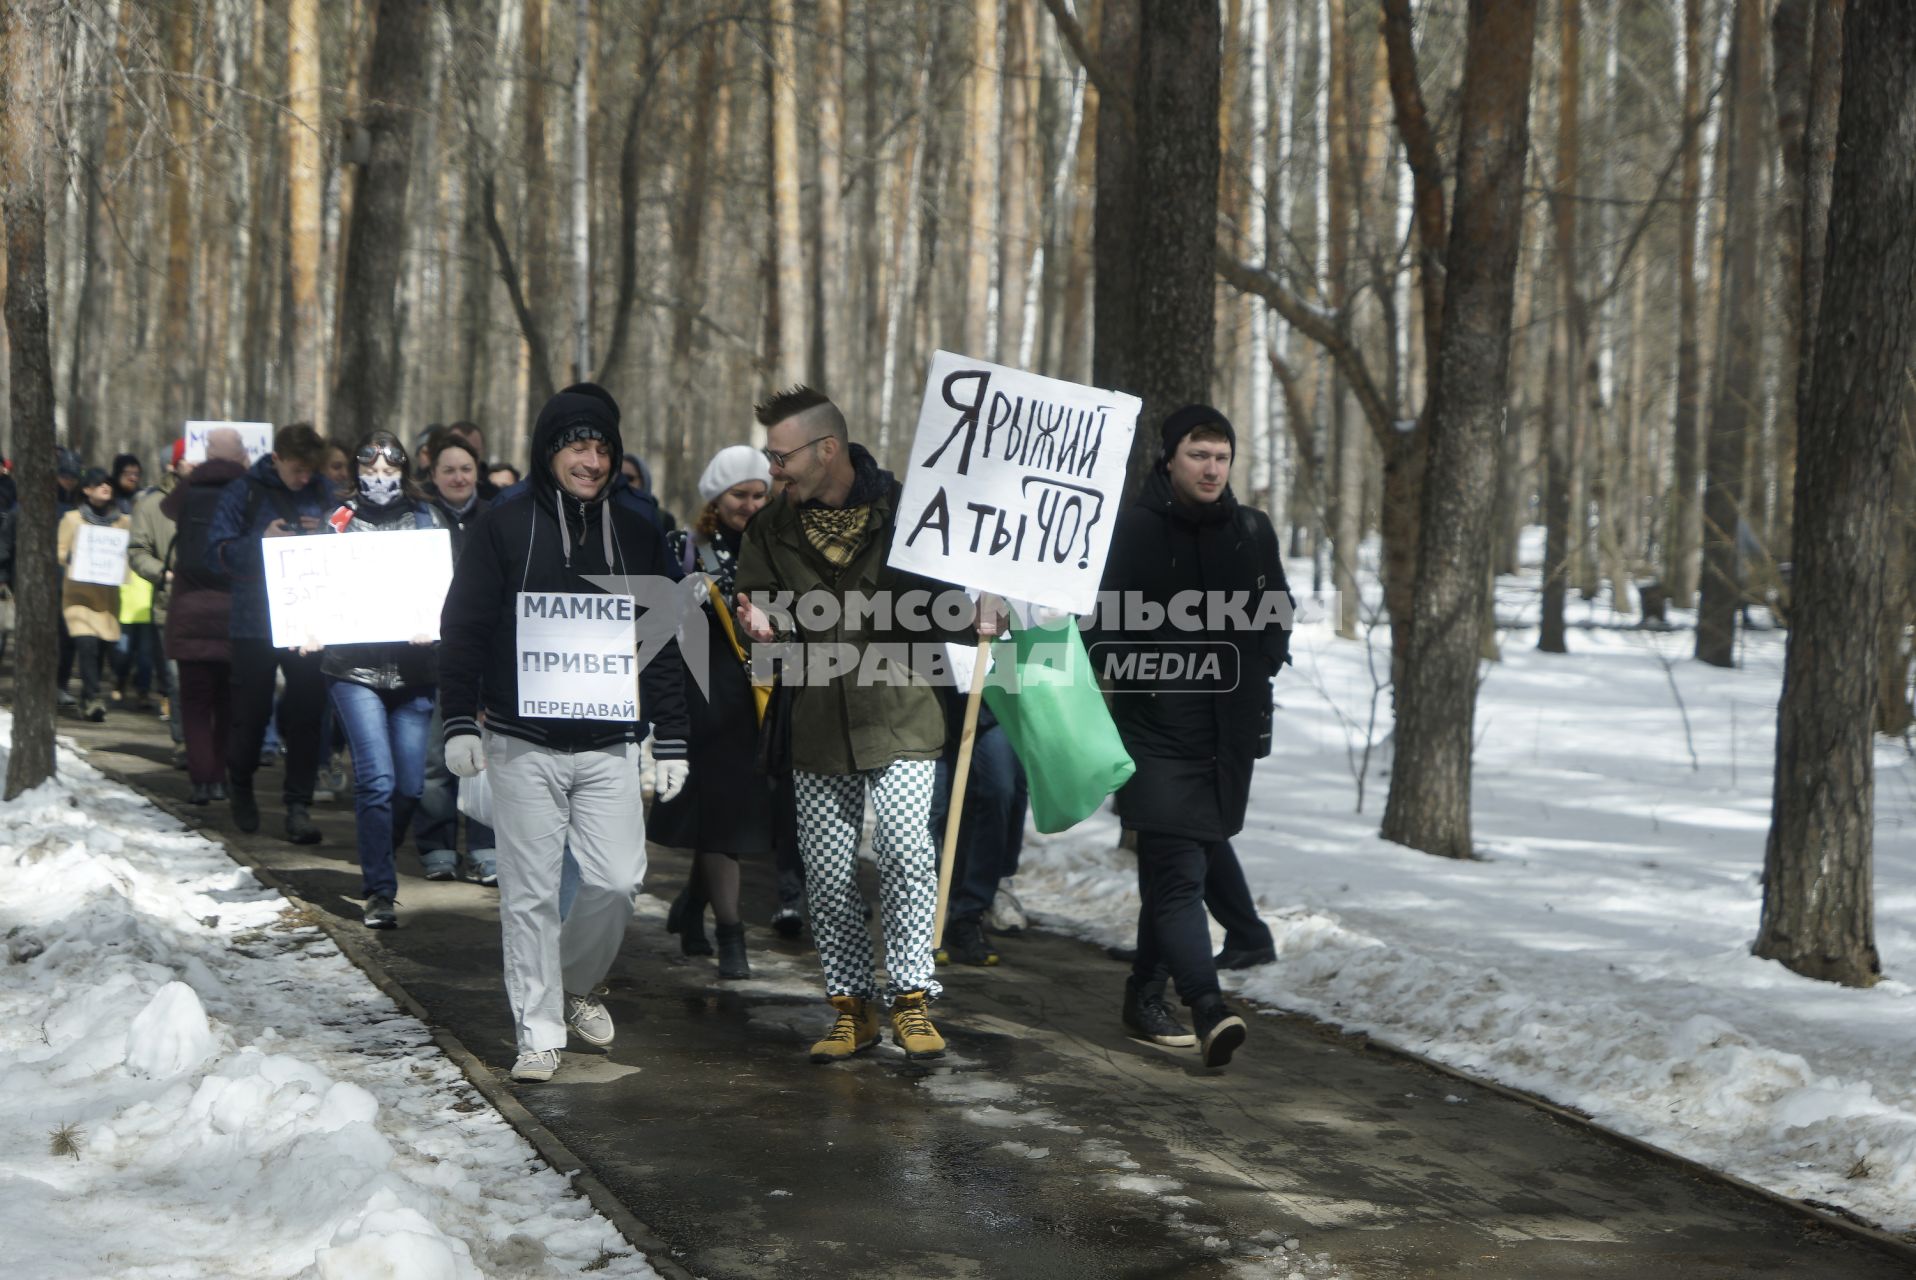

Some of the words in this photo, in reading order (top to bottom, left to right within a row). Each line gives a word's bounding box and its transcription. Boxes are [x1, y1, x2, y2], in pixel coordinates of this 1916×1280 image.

[922, 370, 991, 475] Я
[905, 486, 950, 556] А
[523, 595, 632, 621] МАМКЕ
[522, 651, 634, 675] ПРИВЕТ
[523, 700, 635, 719] ПЕРЕДАВАЙ
